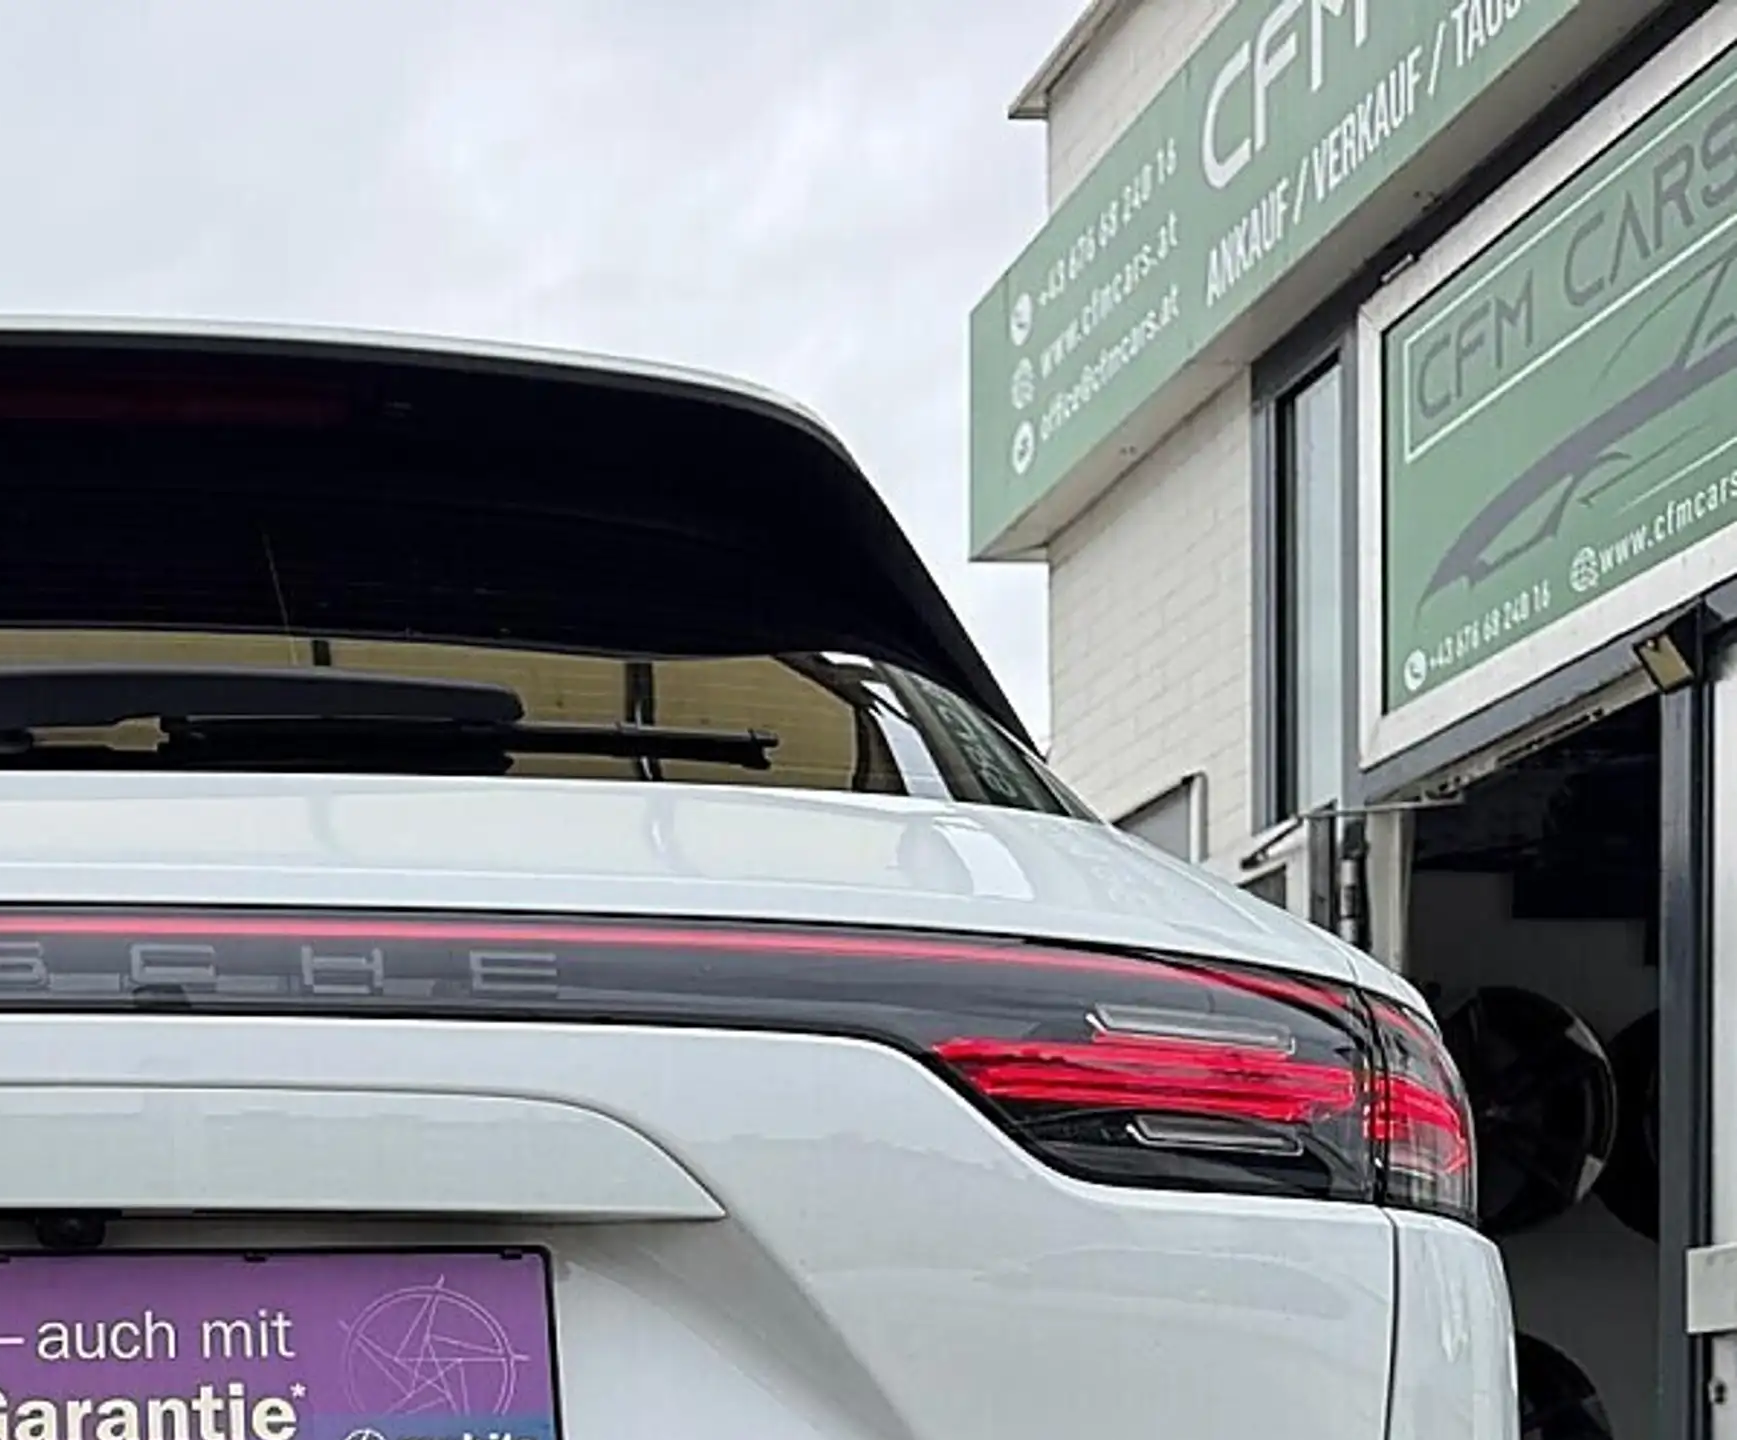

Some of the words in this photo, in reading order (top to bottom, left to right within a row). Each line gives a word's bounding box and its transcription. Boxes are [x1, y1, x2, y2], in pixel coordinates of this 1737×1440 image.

[1068, 225, 1096, 281] 676
[1156, 137, 1177, 185] 16
[1207, 178, 1290, 307] ANKAUF
[1312, 45, 1423, 202] VERKAUF
[1040, 209, 1178, 379] www.cfmcars.at
[1418, 268, 1534, 419] CFM
[1563, 100, 1737, 308] CARS
[1040, 284, 1179, 441] office@cfmcars.at
[1456, 619, 1480, 660] 676
[1533, 578, 1551, 613] 16
[36, 1310, 178, 1361] auch
[201, 1308, 296, 1360] mit
